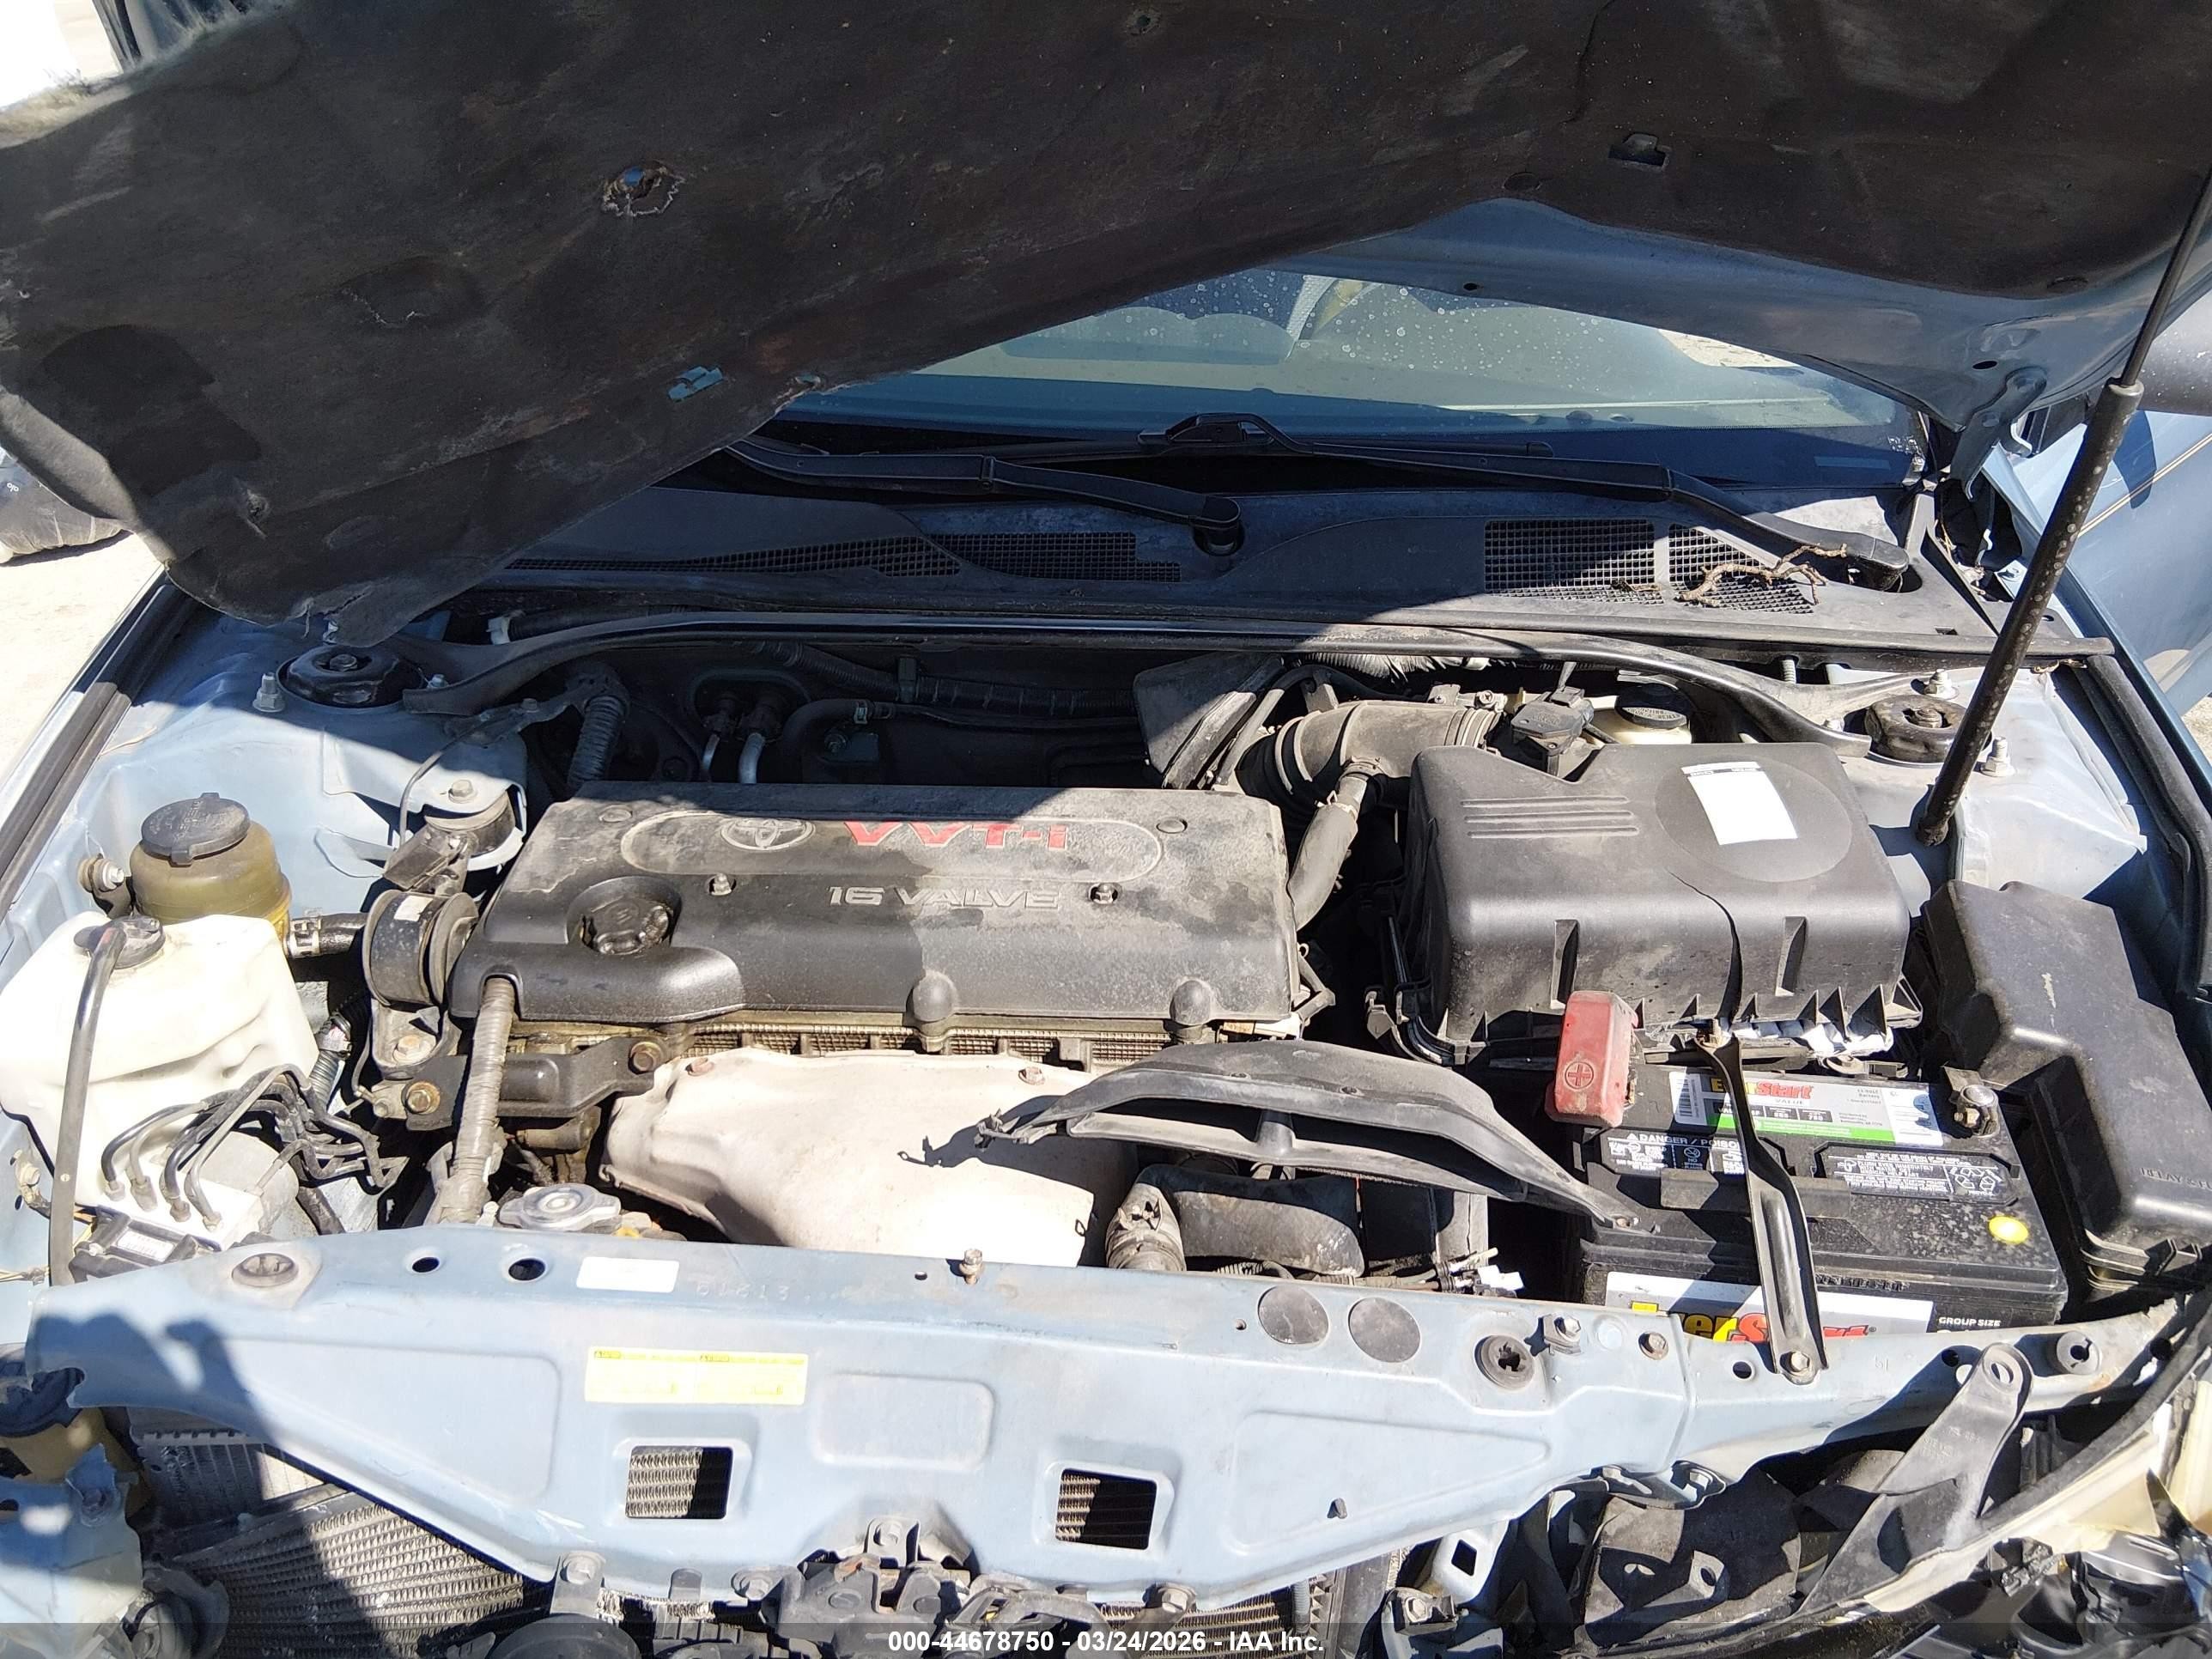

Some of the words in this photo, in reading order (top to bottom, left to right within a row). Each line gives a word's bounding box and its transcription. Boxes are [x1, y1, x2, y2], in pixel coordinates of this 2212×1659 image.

[827, 885, 884, 906] 16
[893, 885, 1062, 909] VALVE
[1639, 1133, 1688, 1145] DANGER
[1700, 1139, 1738, 1149] POISO
[2141, 1168, 2182, 1183] RELAY
[1938, 1316, 1977, 1326] GROUP
